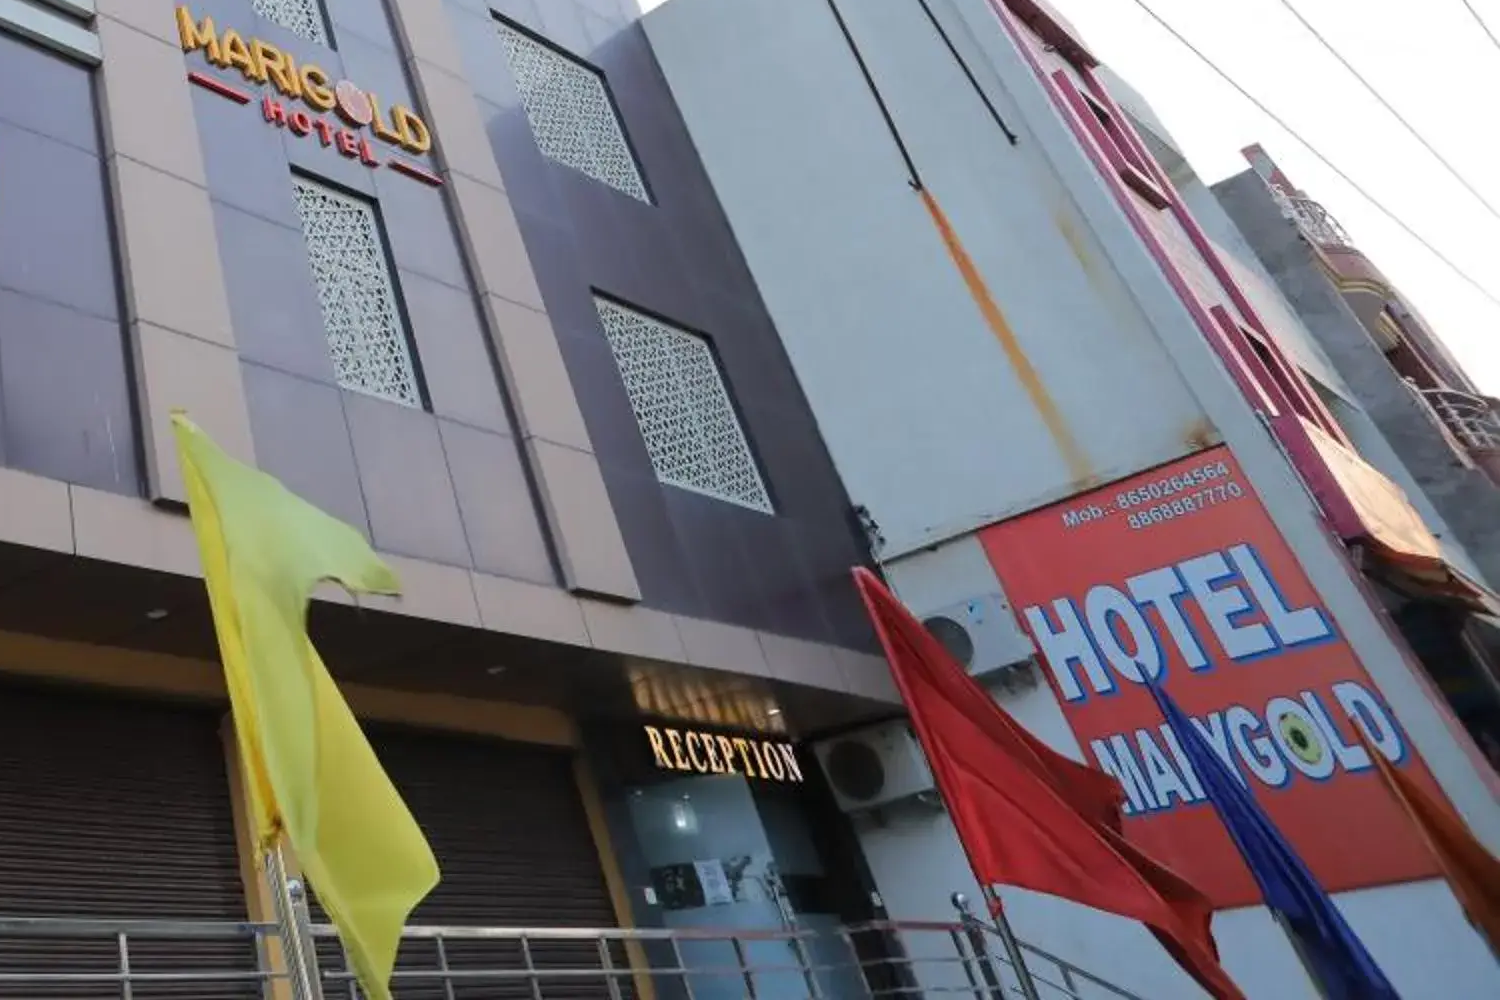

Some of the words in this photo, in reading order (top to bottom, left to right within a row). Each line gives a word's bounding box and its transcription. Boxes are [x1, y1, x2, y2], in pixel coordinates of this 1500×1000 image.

[174, 3, 432, 156] MARIGOLD
[261, 96, 380, 168] HOTEL
[1023, 543, 1335, 703] HOTEL
[645, 725, 804, 783] RECEPTION
